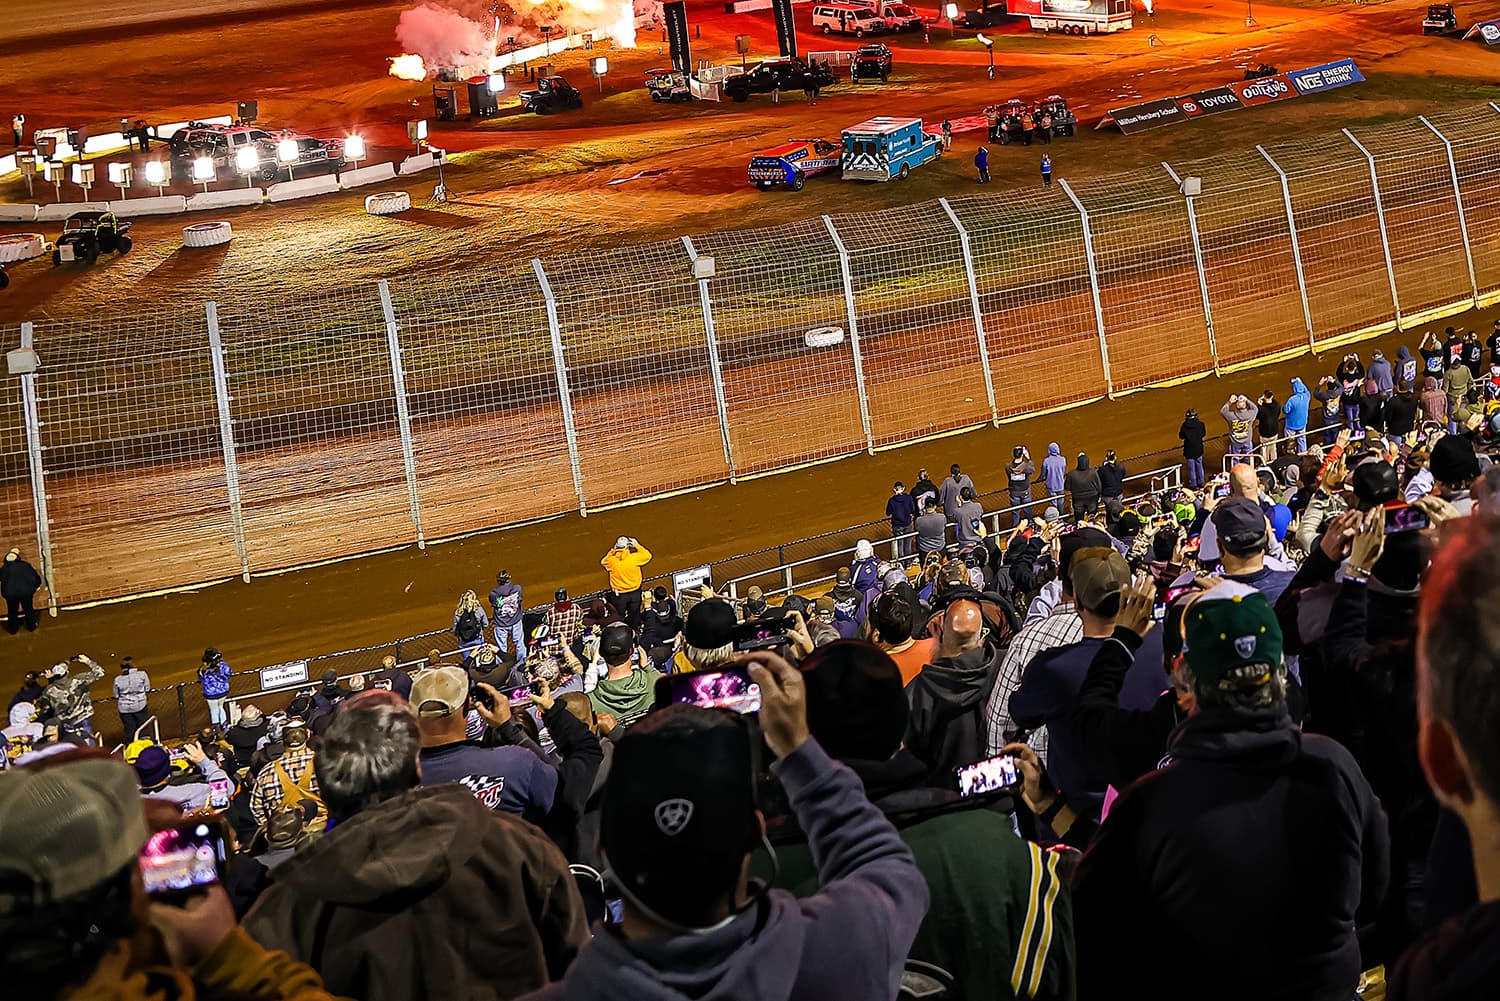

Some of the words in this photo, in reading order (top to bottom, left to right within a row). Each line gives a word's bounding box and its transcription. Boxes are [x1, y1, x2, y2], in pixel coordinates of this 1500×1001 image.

[1321, 64, 1354, 78] ENERGY
[1295, 72, 1324, 91] NOS
[1327, 73, 1353, 85] DRINK
[1242, 80, 1288, 98] OUTLAWS
[1198, 94, 1239, 108] TOYOTA
[1138, 110, 1160, 123] Hershey
[1161, 106, 1179, 117] School
[275, 671, 303, 680] STANDING
